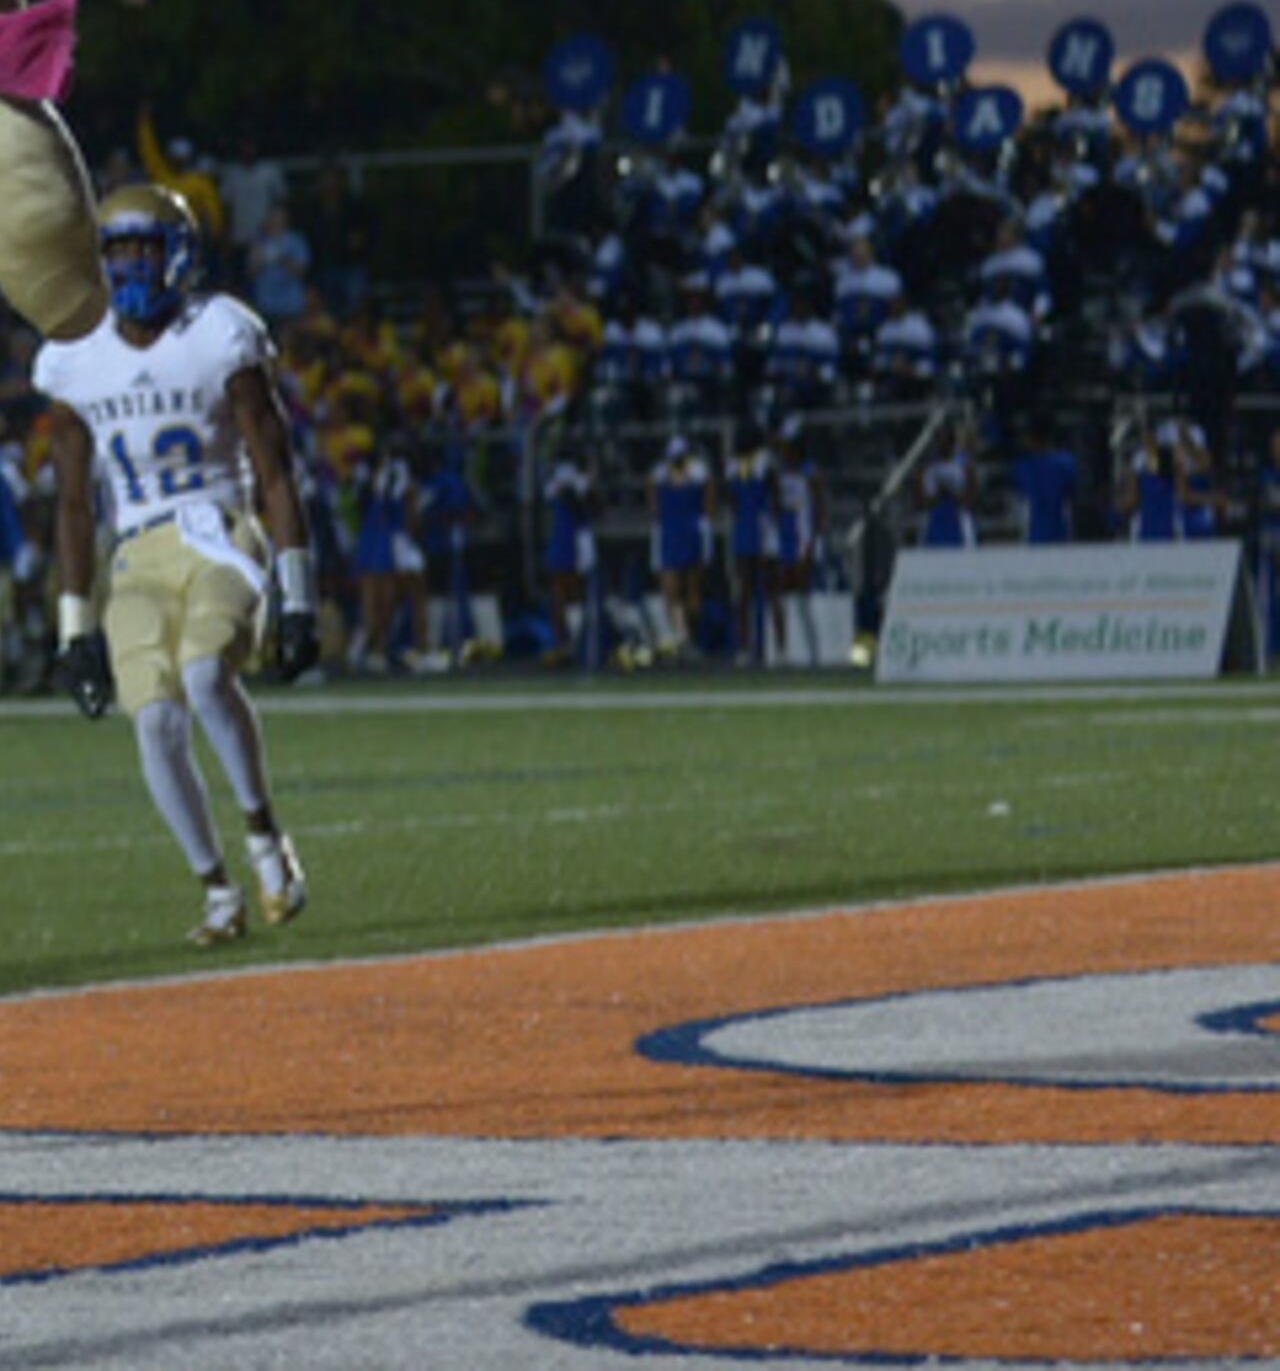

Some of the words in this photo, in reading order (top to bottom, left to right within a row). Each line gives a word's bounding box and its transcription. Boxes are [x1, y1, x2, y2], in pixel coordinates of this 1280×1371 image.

[108, 422, 209, 508] 12
[887, 620, 1011, 668] Sports
[1022, 614, 1208, 656] Medicine
